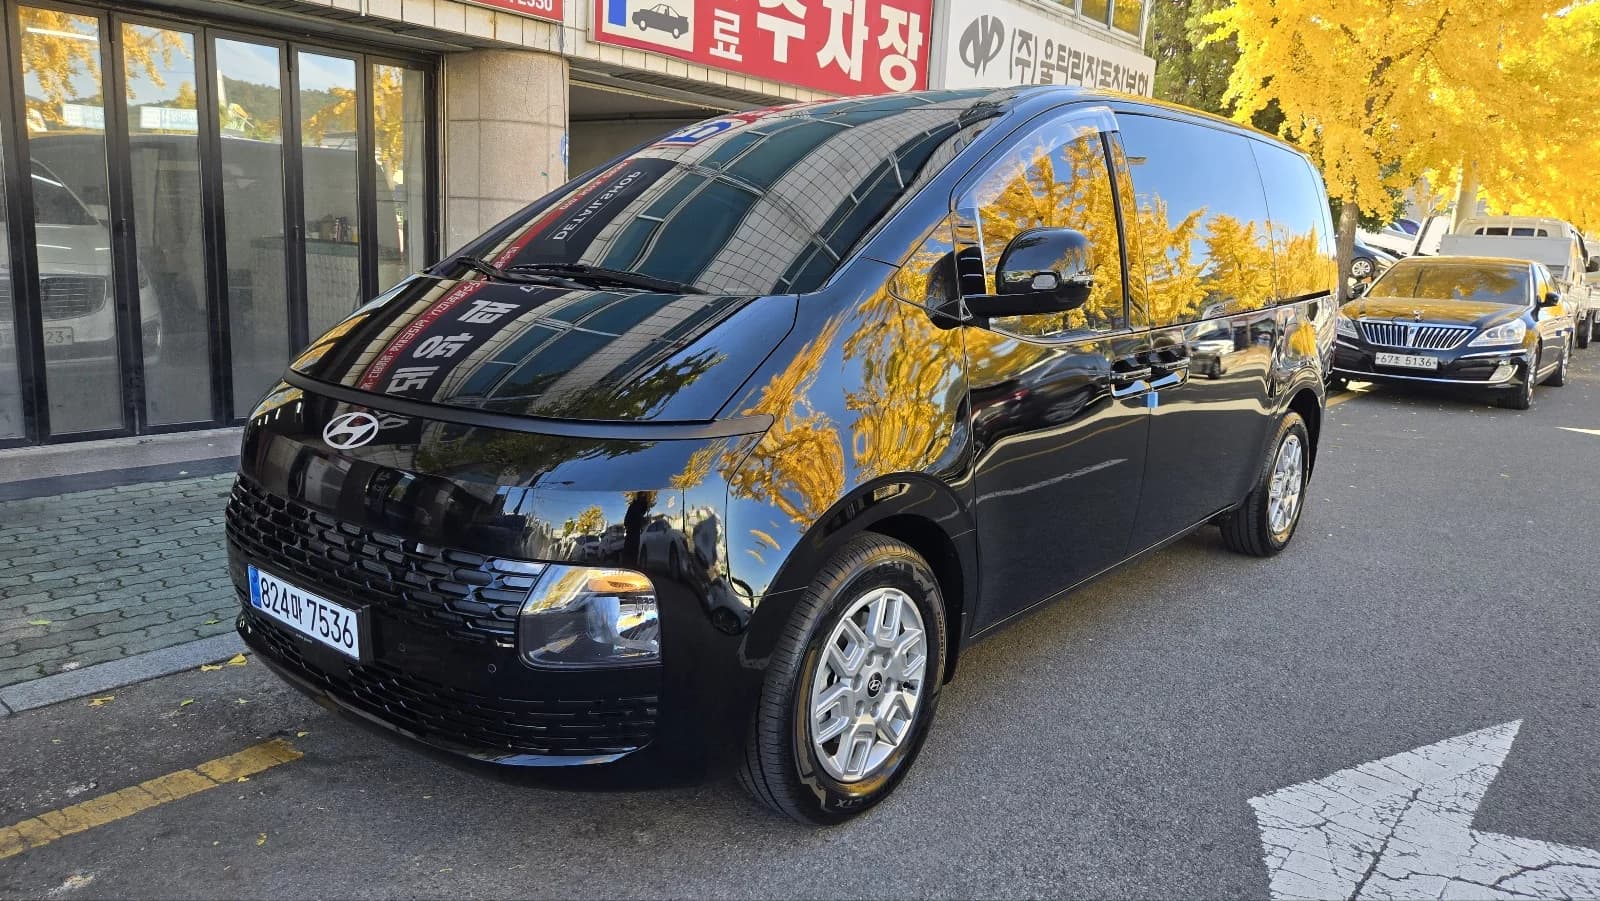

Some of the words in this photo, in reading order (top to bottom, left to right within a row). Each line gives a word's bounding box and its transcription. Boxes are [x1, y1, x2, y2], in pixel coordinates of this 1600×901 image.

[757, 0, 923, 92] 주차장
[1405, 356, 1432, 367] 5136
[260, 577, 303, 625] 824마
[306, 598, 354, 649] 7536
